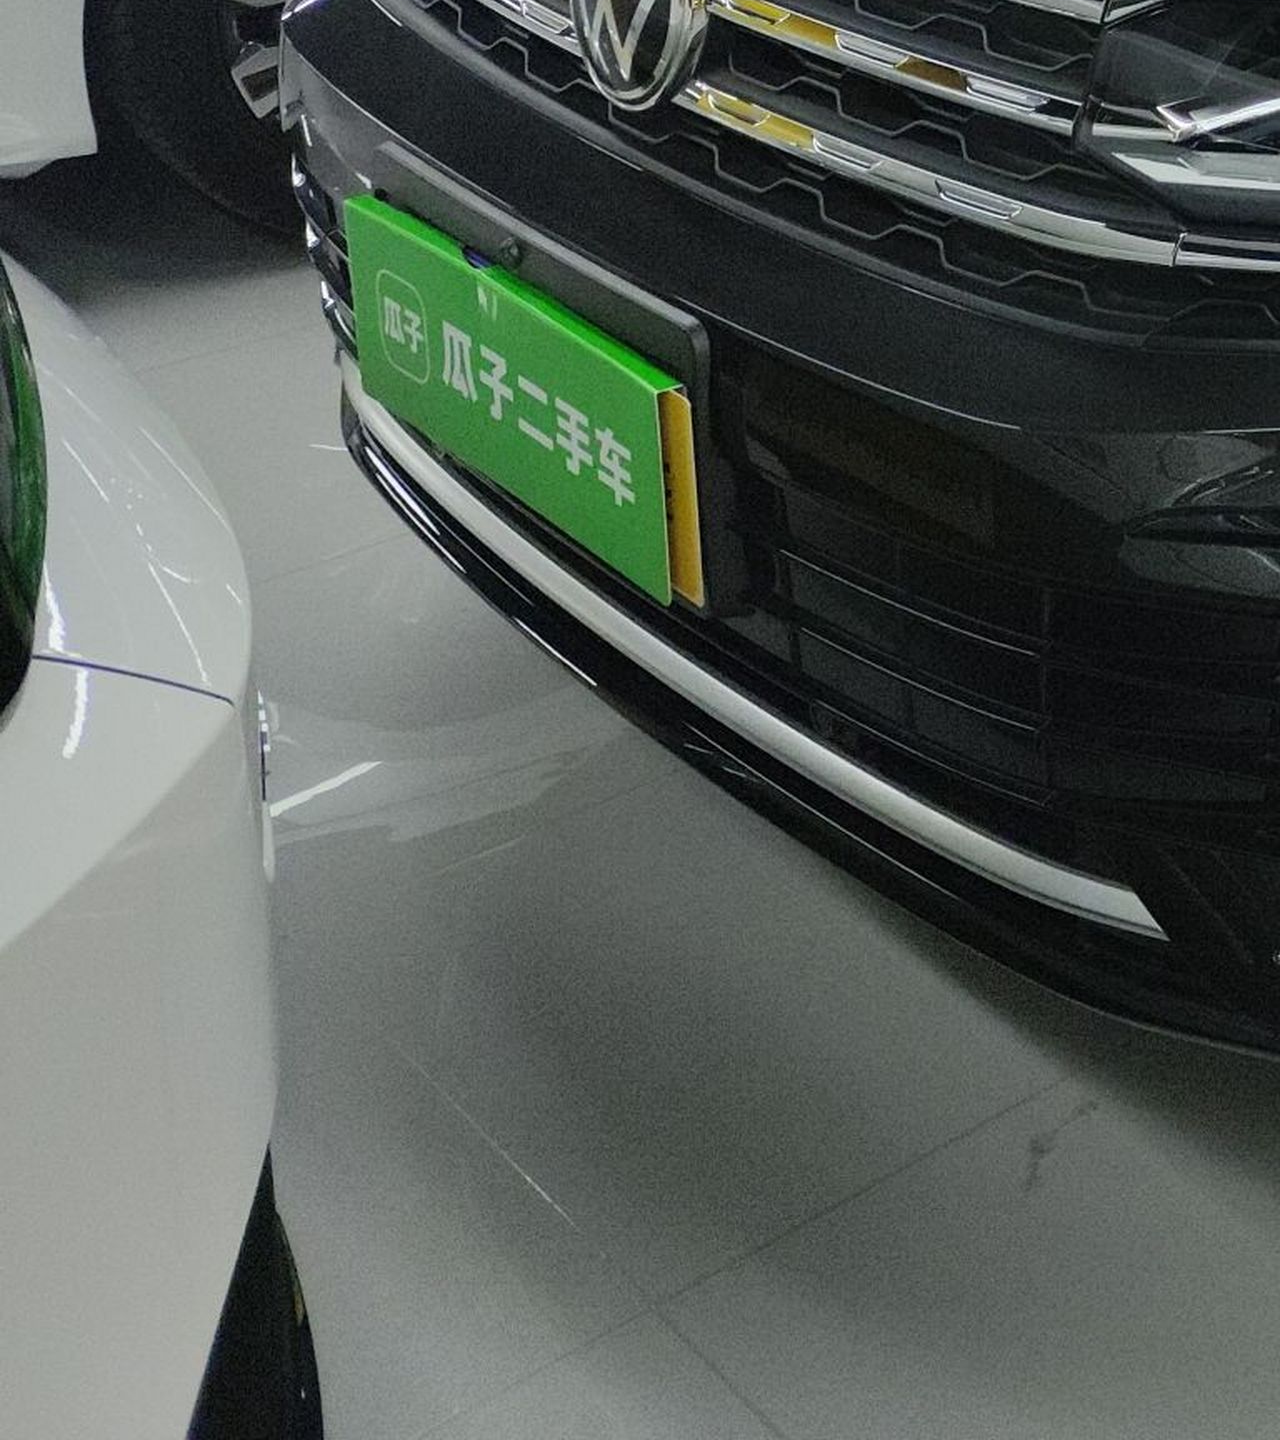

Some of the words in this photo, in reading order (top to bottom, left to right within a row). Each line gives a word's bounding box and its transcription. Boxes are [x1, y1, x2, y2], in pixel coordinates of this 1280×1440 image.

[382, 296, 426, 354] 瓜子
[441, 319, 636, 507] 瓜子二手车
